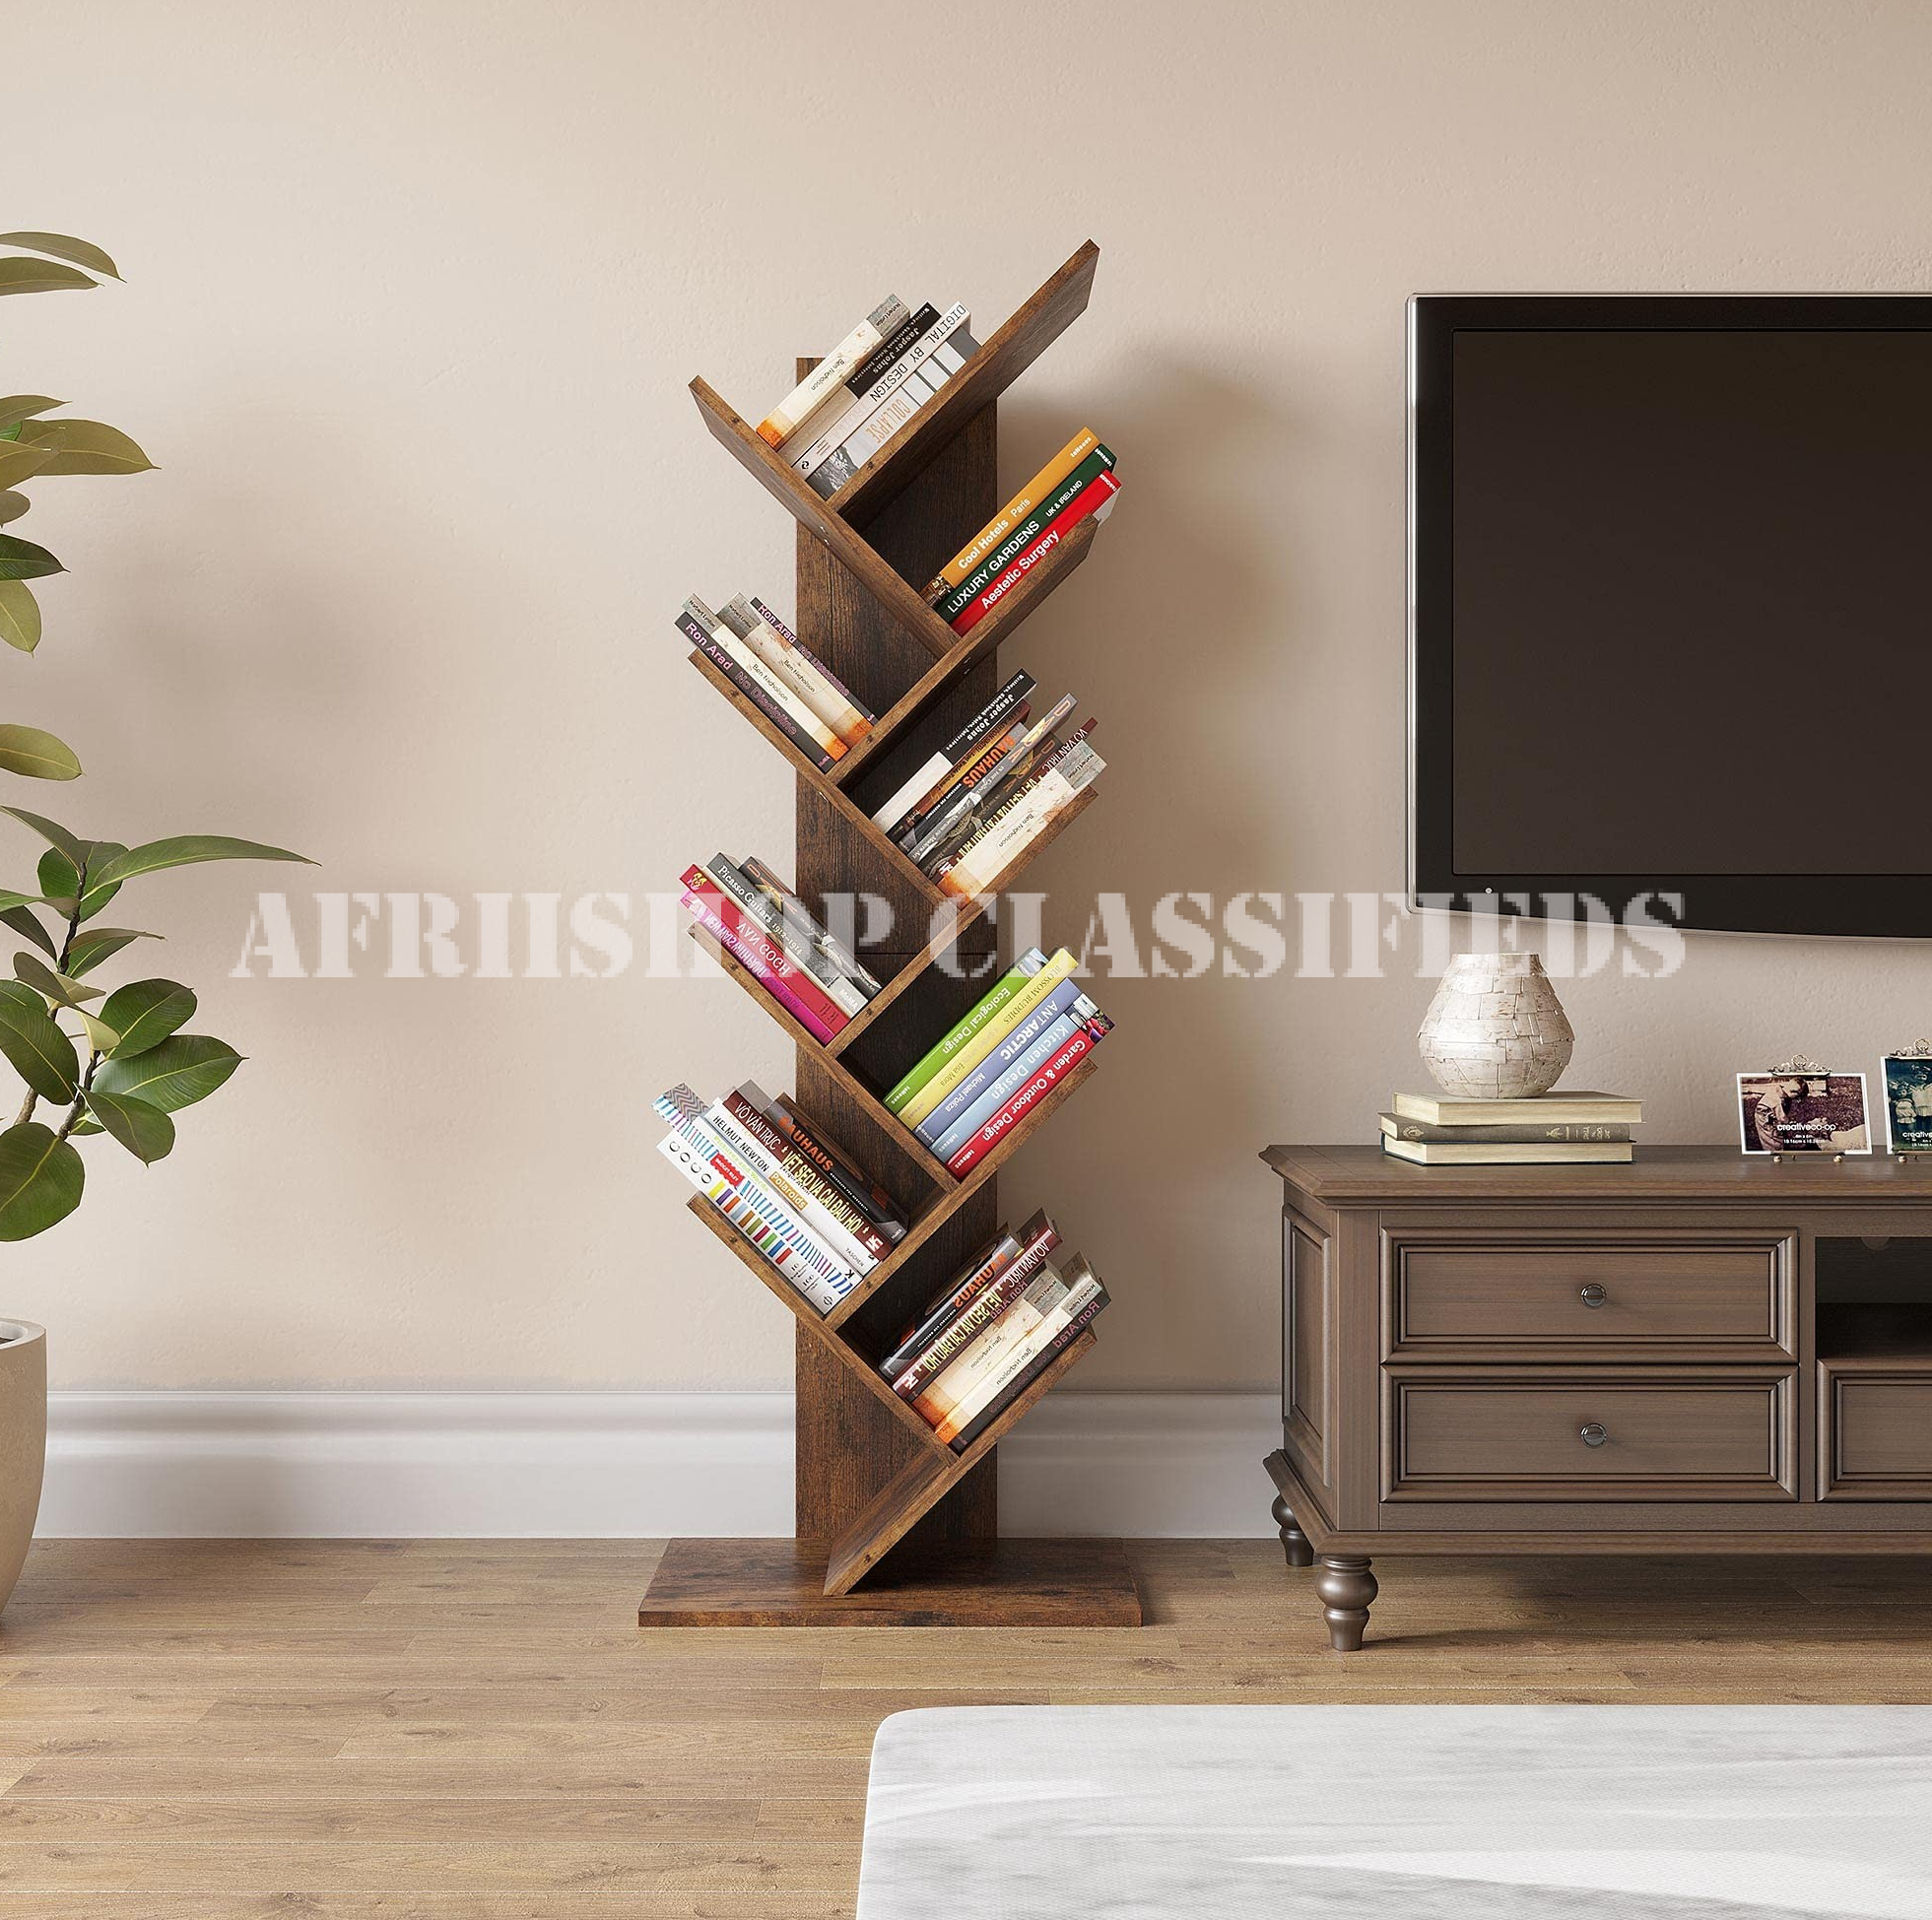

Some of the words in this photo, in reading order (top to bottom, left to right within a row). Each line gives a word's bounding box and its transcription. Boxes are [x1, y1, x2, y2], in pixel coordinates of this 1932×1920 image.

[892, 325, 920, 354] Jasper
[924, 303, 966, 347] DIGITAL
[832, 357, 844, 370] Ben
[871, 350, 897, 375] Johns
[907, 345, 925, 363] BY
[809, 366, 834, 392] Nicholson
[868, 362, 908, 402] DESIGN
[864, 396, 911, 444] COLLAPSE
[1009, 496, 1031, 517] Paris
[1044, 505, 1057, 517] UK
[1052, 500, 1061, 509] &
[1057, 479, 1084, 504] IRELAND
[957, 545, 981, 569] Cool
[976, 516, 1009, 550] Hotels
[947, 567, 991, 614] LUXURY
[986, 518, 1040, 572] GARDENS
[978, 565, 1023, 609] Aestetic
[1017, 528, 1062, 572] Surgery
[757, 604, 777, 625] Ron
[773, 621, 797, 644] Arad
[684, 621, 709, 647] Ron
[705, 642, 734, 671] Arad
[751, 663, 765, 678] Ben
[761, 674, 790, 702] Nicholson
[782, 659, 795, 672] Ben
[733, 670, 754, 691] No
[748, 686, 800, 738] Discipline
[986, 692, 1015, 721] Jasper
[966, 717, 991, 743] Johns
[961, 733, 1017, 789] BAUHAUS
[996, 822, 1024, 848] Nicholson
[1020, 812, 1034, 826] Ben
[716, 864, 748, 896] Picasso
[742, 891, 775, 923] Guitars
[1029, 963, 1062, 997] BLOSSOM
[837, 988, 859, 1009] MoMA
[966, 984, 1011, 1028] Ecological
[1001, 993, 1033, 1025] BUDDIES
[940, 1024, 971, 1056] Design
[998, 999, 1060, 1062] ANTARCTIC
[1025, 1023, 1068, 1067] Kitchen
[1051, 1037, 1086, 1072] Garden
[939, 1070, 956, 1088] Mora
[960, 1071, 986, 1097] Michael
[988, 1061, 1029, 1102] Design
[1043, 1067, 1056, 1081] &
[944, 1092, 966, 1113] Poliza
[1009, 1076, 1048, 1116] Outdoor
[711, 1114, 742, 1145] HELMUT
[738, 1141, 769, 1172] NEWTON
[775, 1112, 834, 1173] BAUHAUS
[979, 1109, 1013, 1144] Design
[769, 1172, 806, 1209] Polaroids
[844, 1247, 865, 1267] TASCHEN
